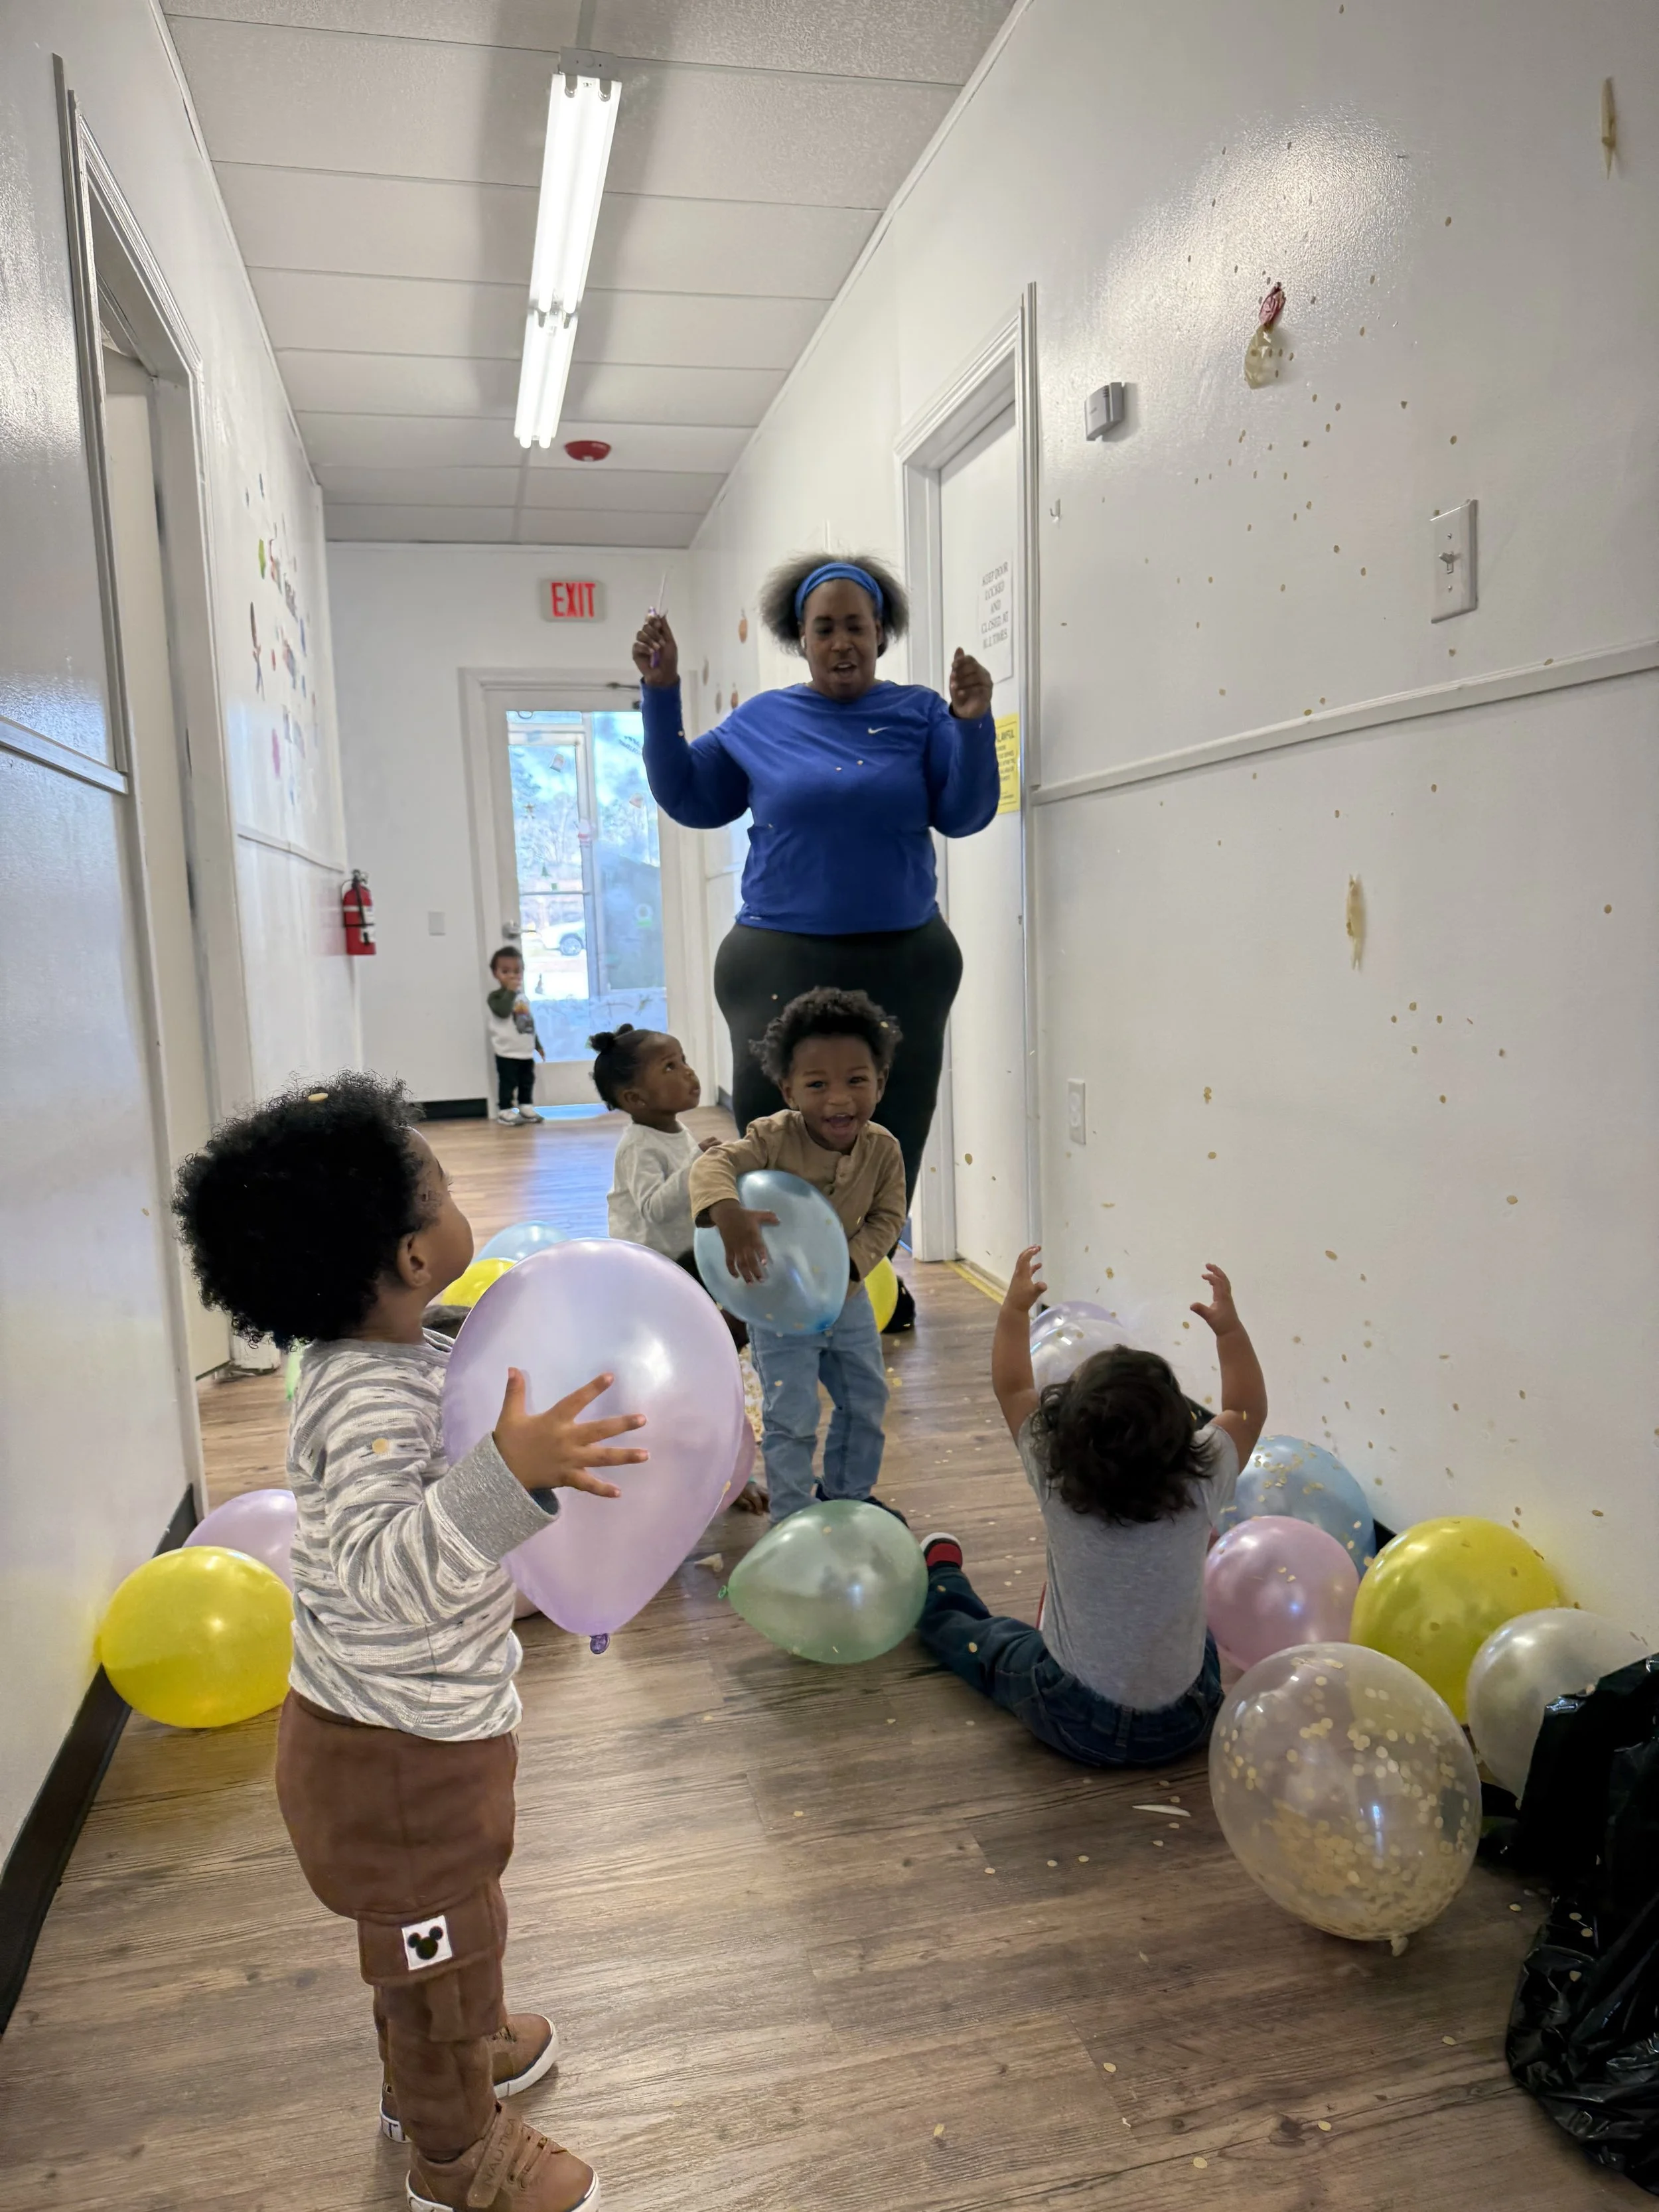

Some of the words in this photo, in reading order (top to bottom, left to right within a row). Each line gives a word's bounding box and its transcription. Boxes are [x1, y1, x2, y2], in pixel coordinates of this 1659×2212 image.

[982, 571, 994, 586] KEEP
[995, 561, 1009, 579] DOOR
[551, 582, 596, 618] EXIT
[985, 580, 1005, 601] LOCKED
[991, 599, 1001, 614] AND
[981, 615, 1001, 634] CLOSED
[993, 628, 1009, 644] TIMES
[482, 2118, 516, 2187] NAUTICA
